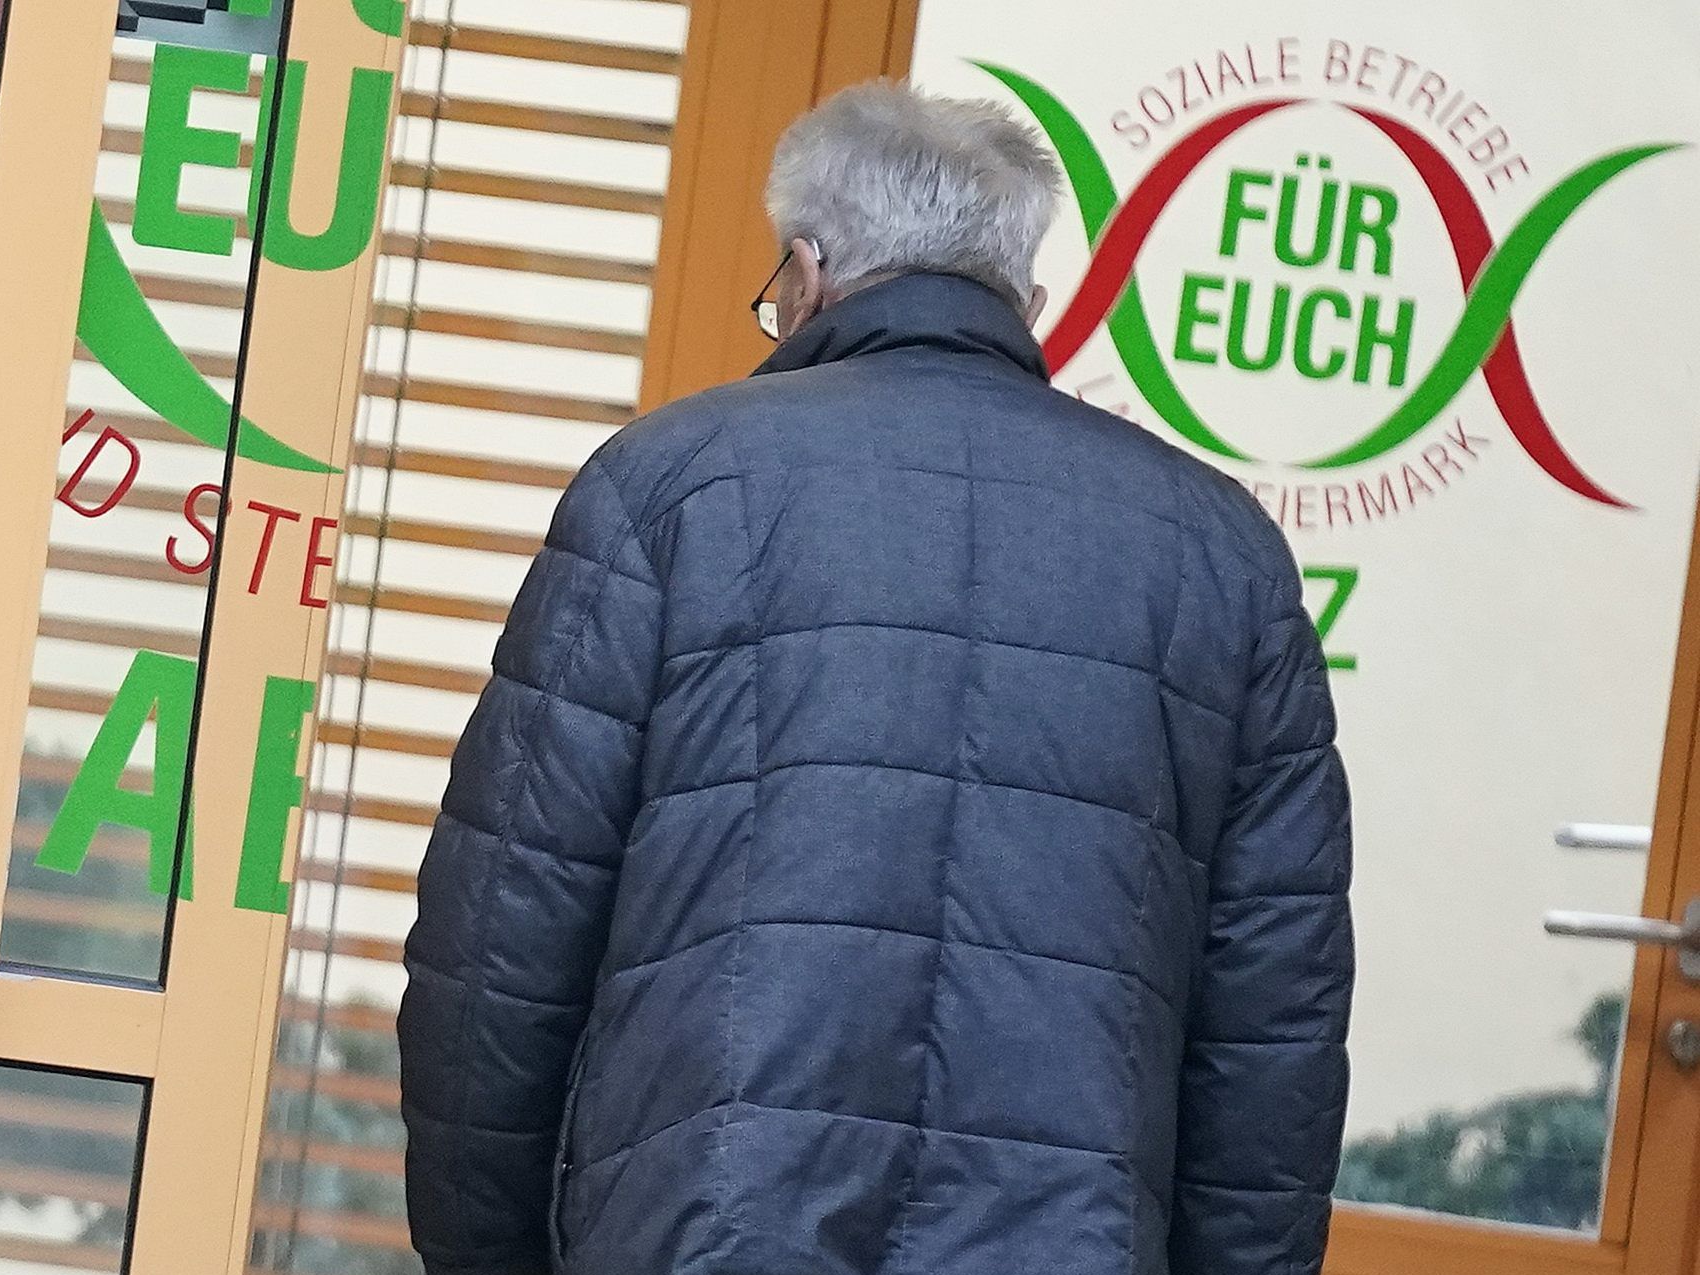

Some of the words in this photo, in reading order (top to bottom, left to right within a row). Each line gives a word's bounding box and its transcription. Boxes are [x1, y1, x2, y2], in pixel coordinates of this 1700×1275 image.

[1112, 36, 1301, 150] SOZIALE
[1324, 39, 1531, 194] BETRIEBE
[1218, 152, 1399, 276] FÜR
[1173, 271, 1416, 387] EUCH
